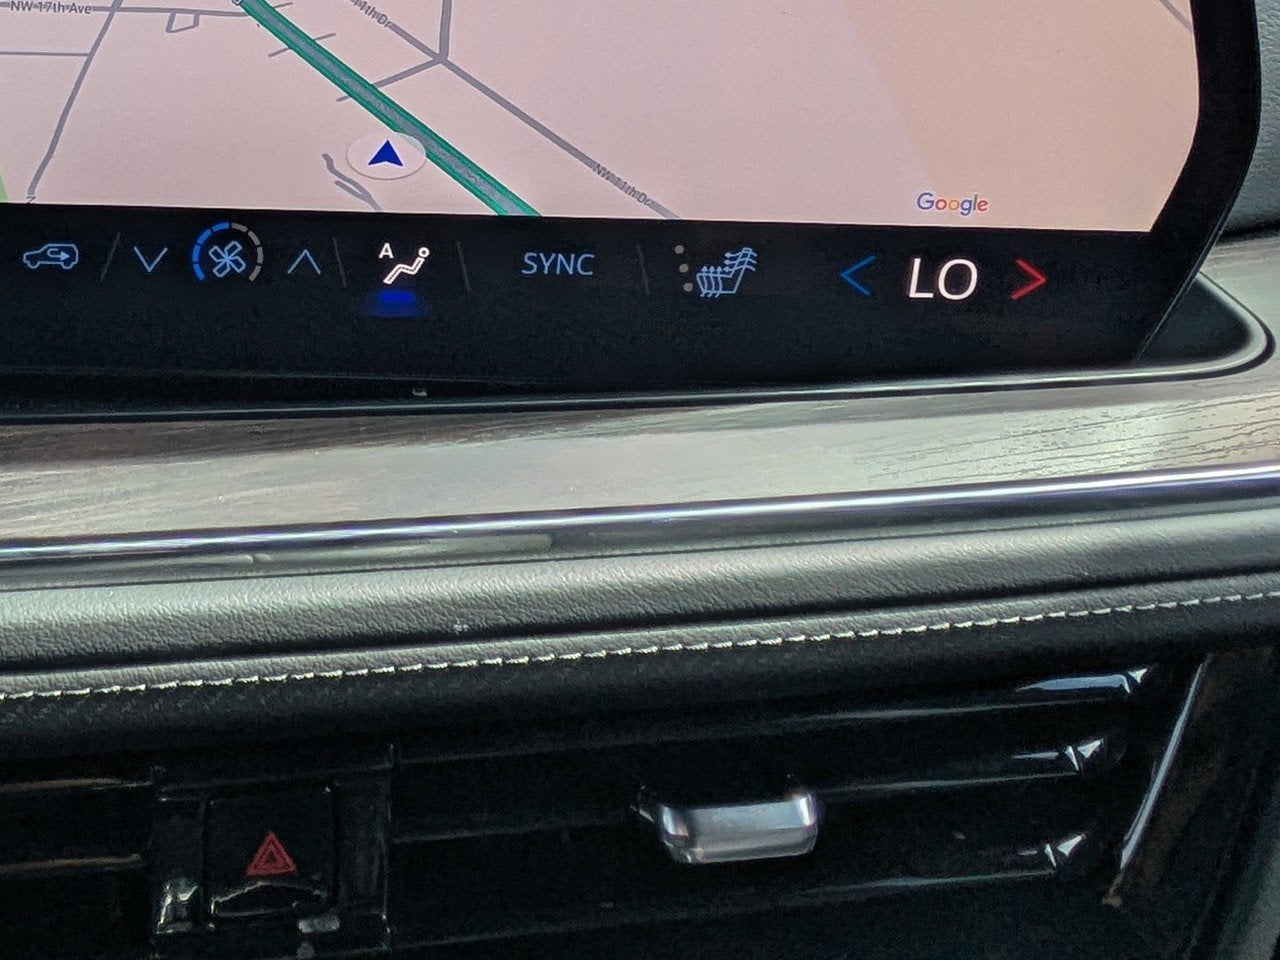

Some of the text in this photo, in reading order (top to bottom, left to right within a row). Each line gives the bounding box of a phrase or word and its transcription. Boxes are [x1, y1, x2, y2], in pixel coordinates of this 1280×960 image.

[10, 0, 92, 14] NW 17th Ave
[377, 13, 392, 28] Dr
[593, 163, 611, 180] NW
[636, 192, 651, 205] Dr
[916, 191, 989, 217] Google
[379, 242, 394, 259] A
[522, 251, 595, 277] SYNC
[908, 257, 978, 301] LO
